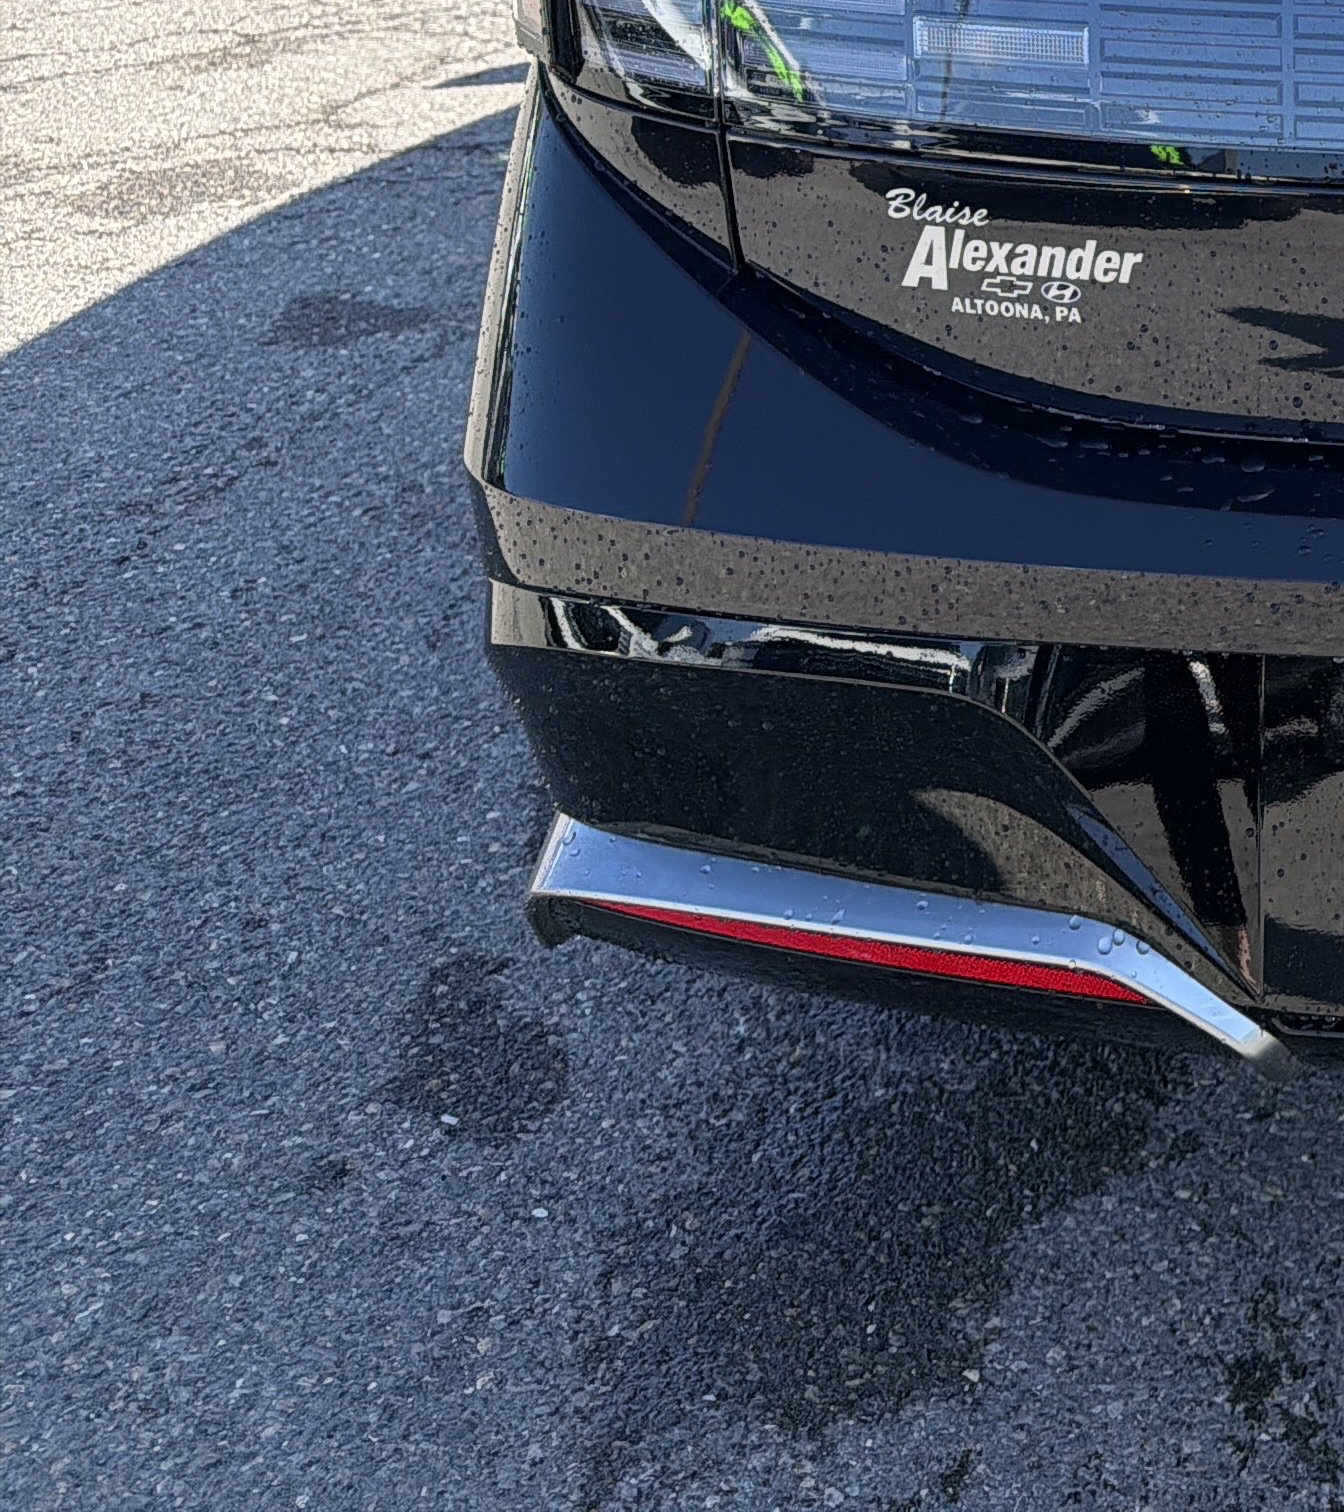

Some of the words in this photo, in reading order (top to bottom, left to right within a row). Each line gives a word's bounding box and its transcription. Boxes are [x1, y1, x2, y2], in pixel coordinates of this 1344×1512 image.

[886, 188, 990, 226] Blaise
[901, 224, 1144, 291] Alexander
[951, 296, 1050, 324] ALTOONA,
[1055, 306, 1082, 324] PA
